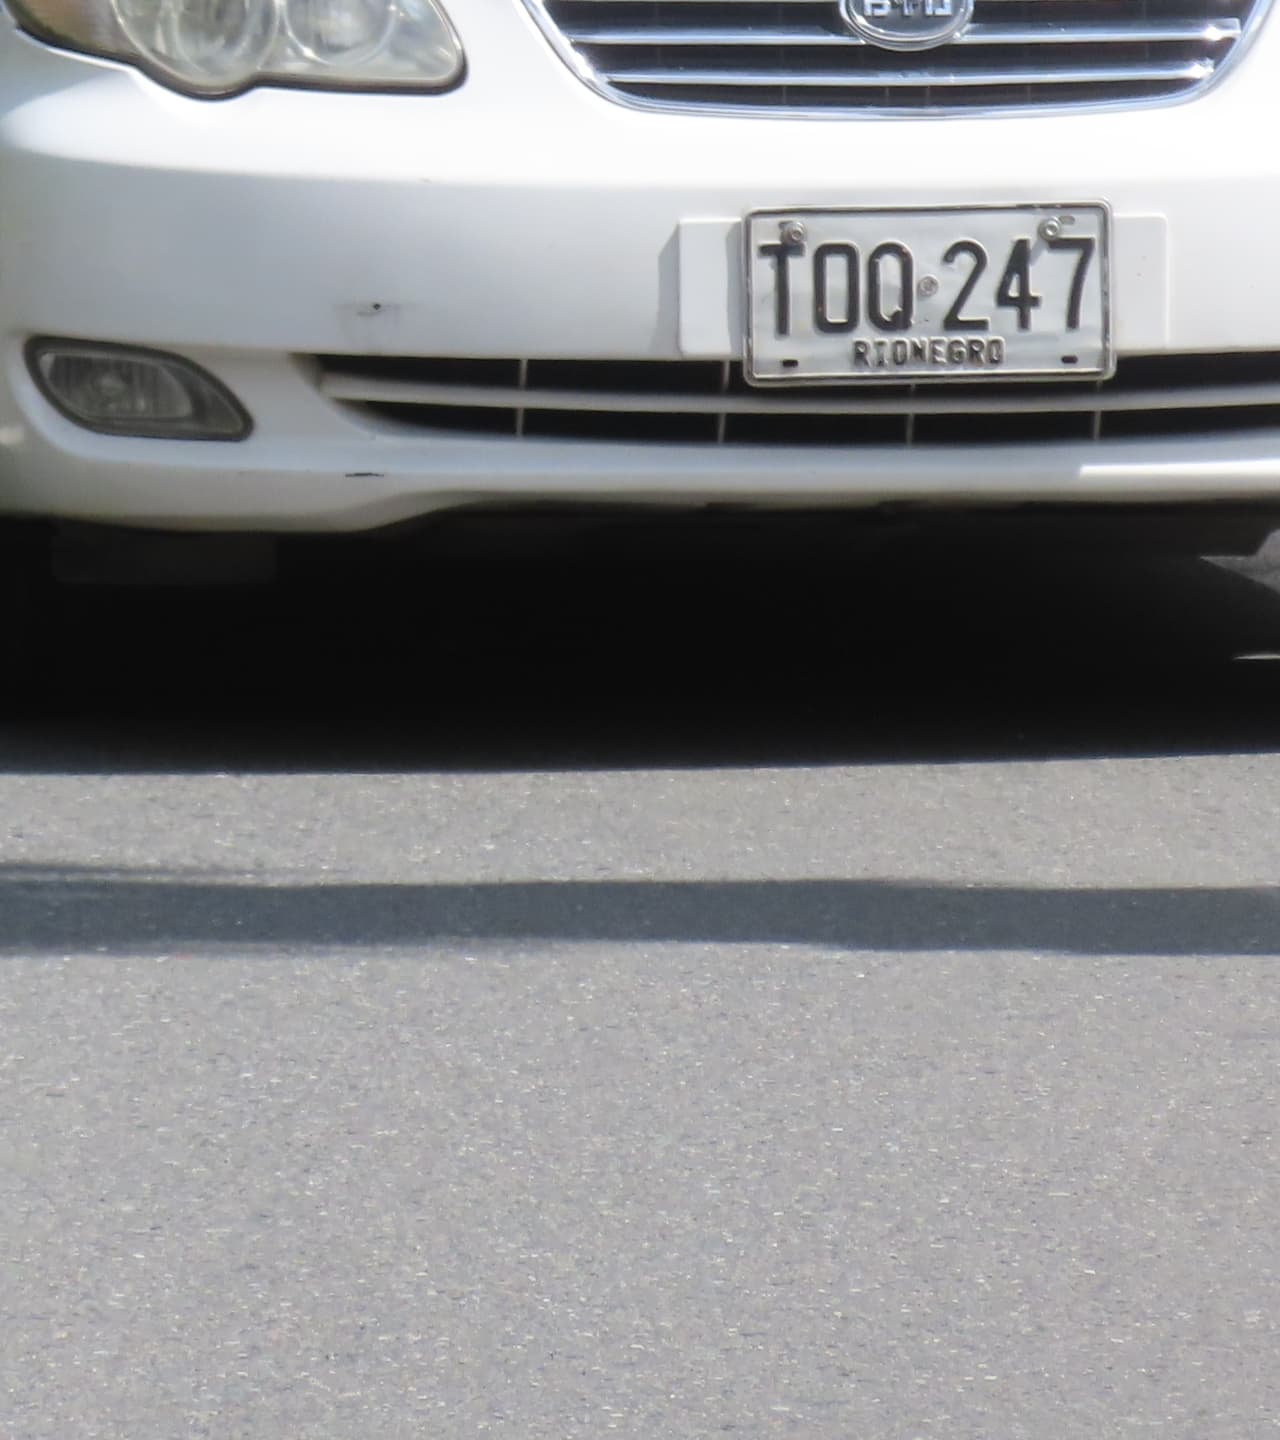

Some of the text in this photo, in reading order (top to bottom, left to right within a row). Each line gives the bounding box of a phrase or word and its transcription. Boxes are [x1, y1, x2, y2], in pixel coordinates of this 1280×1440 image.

[757, 235, 1096, 336] TOQ 247
[851, 335, 1007, 368] RIONEGRO
